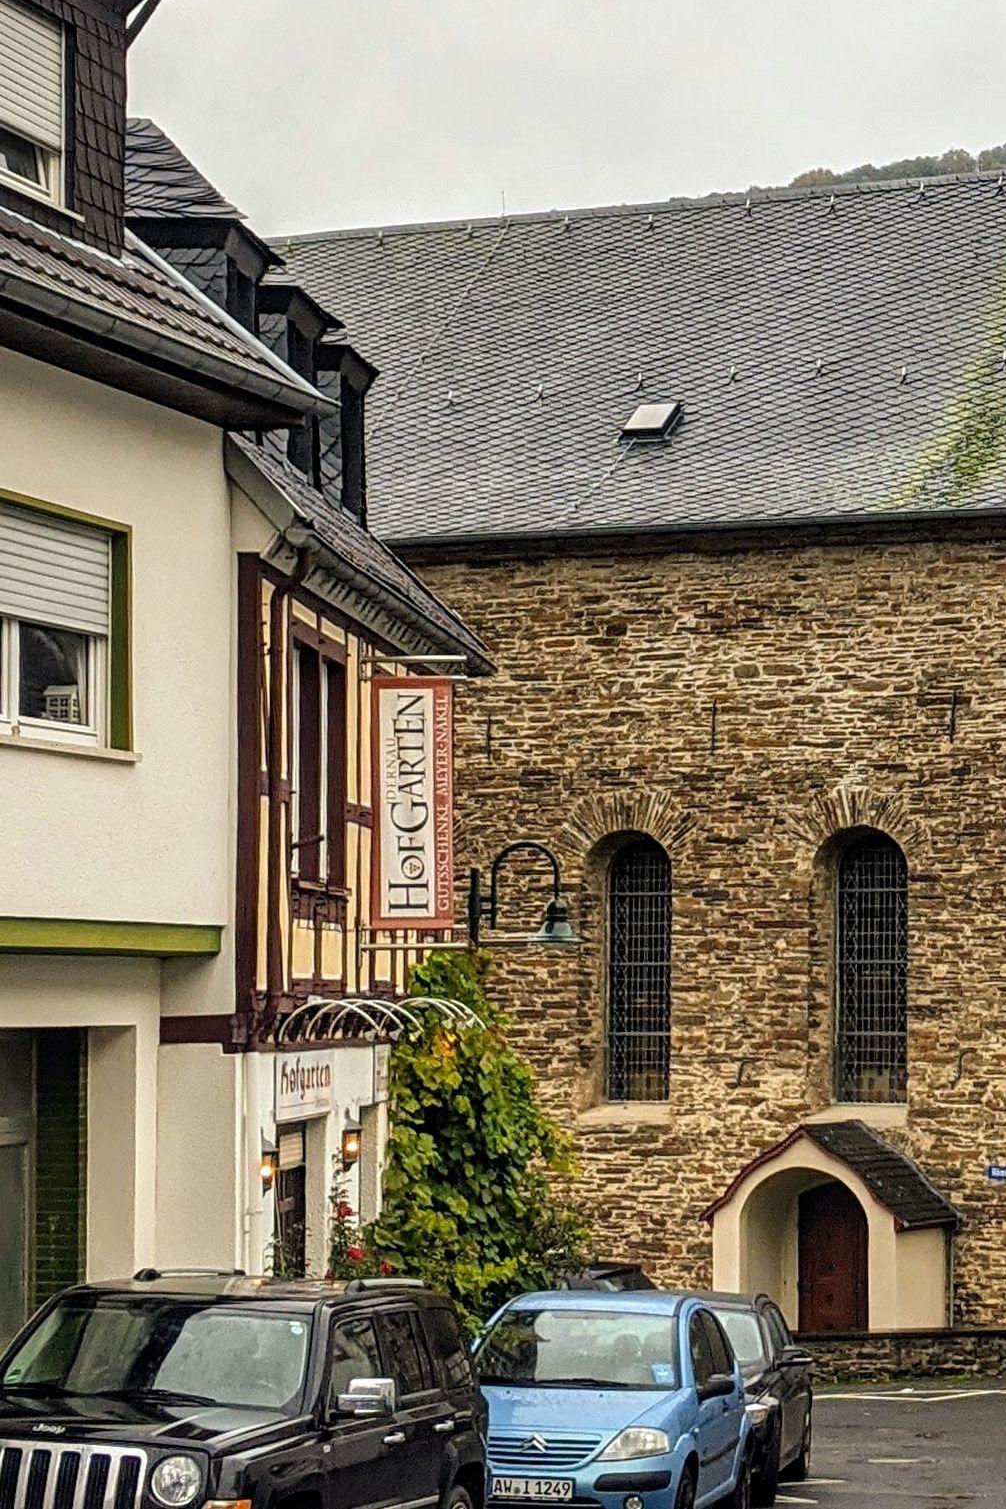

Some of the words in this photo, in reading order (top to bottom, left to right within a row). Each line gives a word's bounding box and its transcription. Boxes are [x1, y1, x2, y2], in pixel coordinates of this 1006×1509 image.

[385, 737, 397, 800] DERNAU
[436, 804, 450, 912] GUTSSCHENKE
[32, 1423, 66, 1434] Jeep
[494, 1479, 513, 1493] AW
[535, 1481, 571, 1496] 1249
